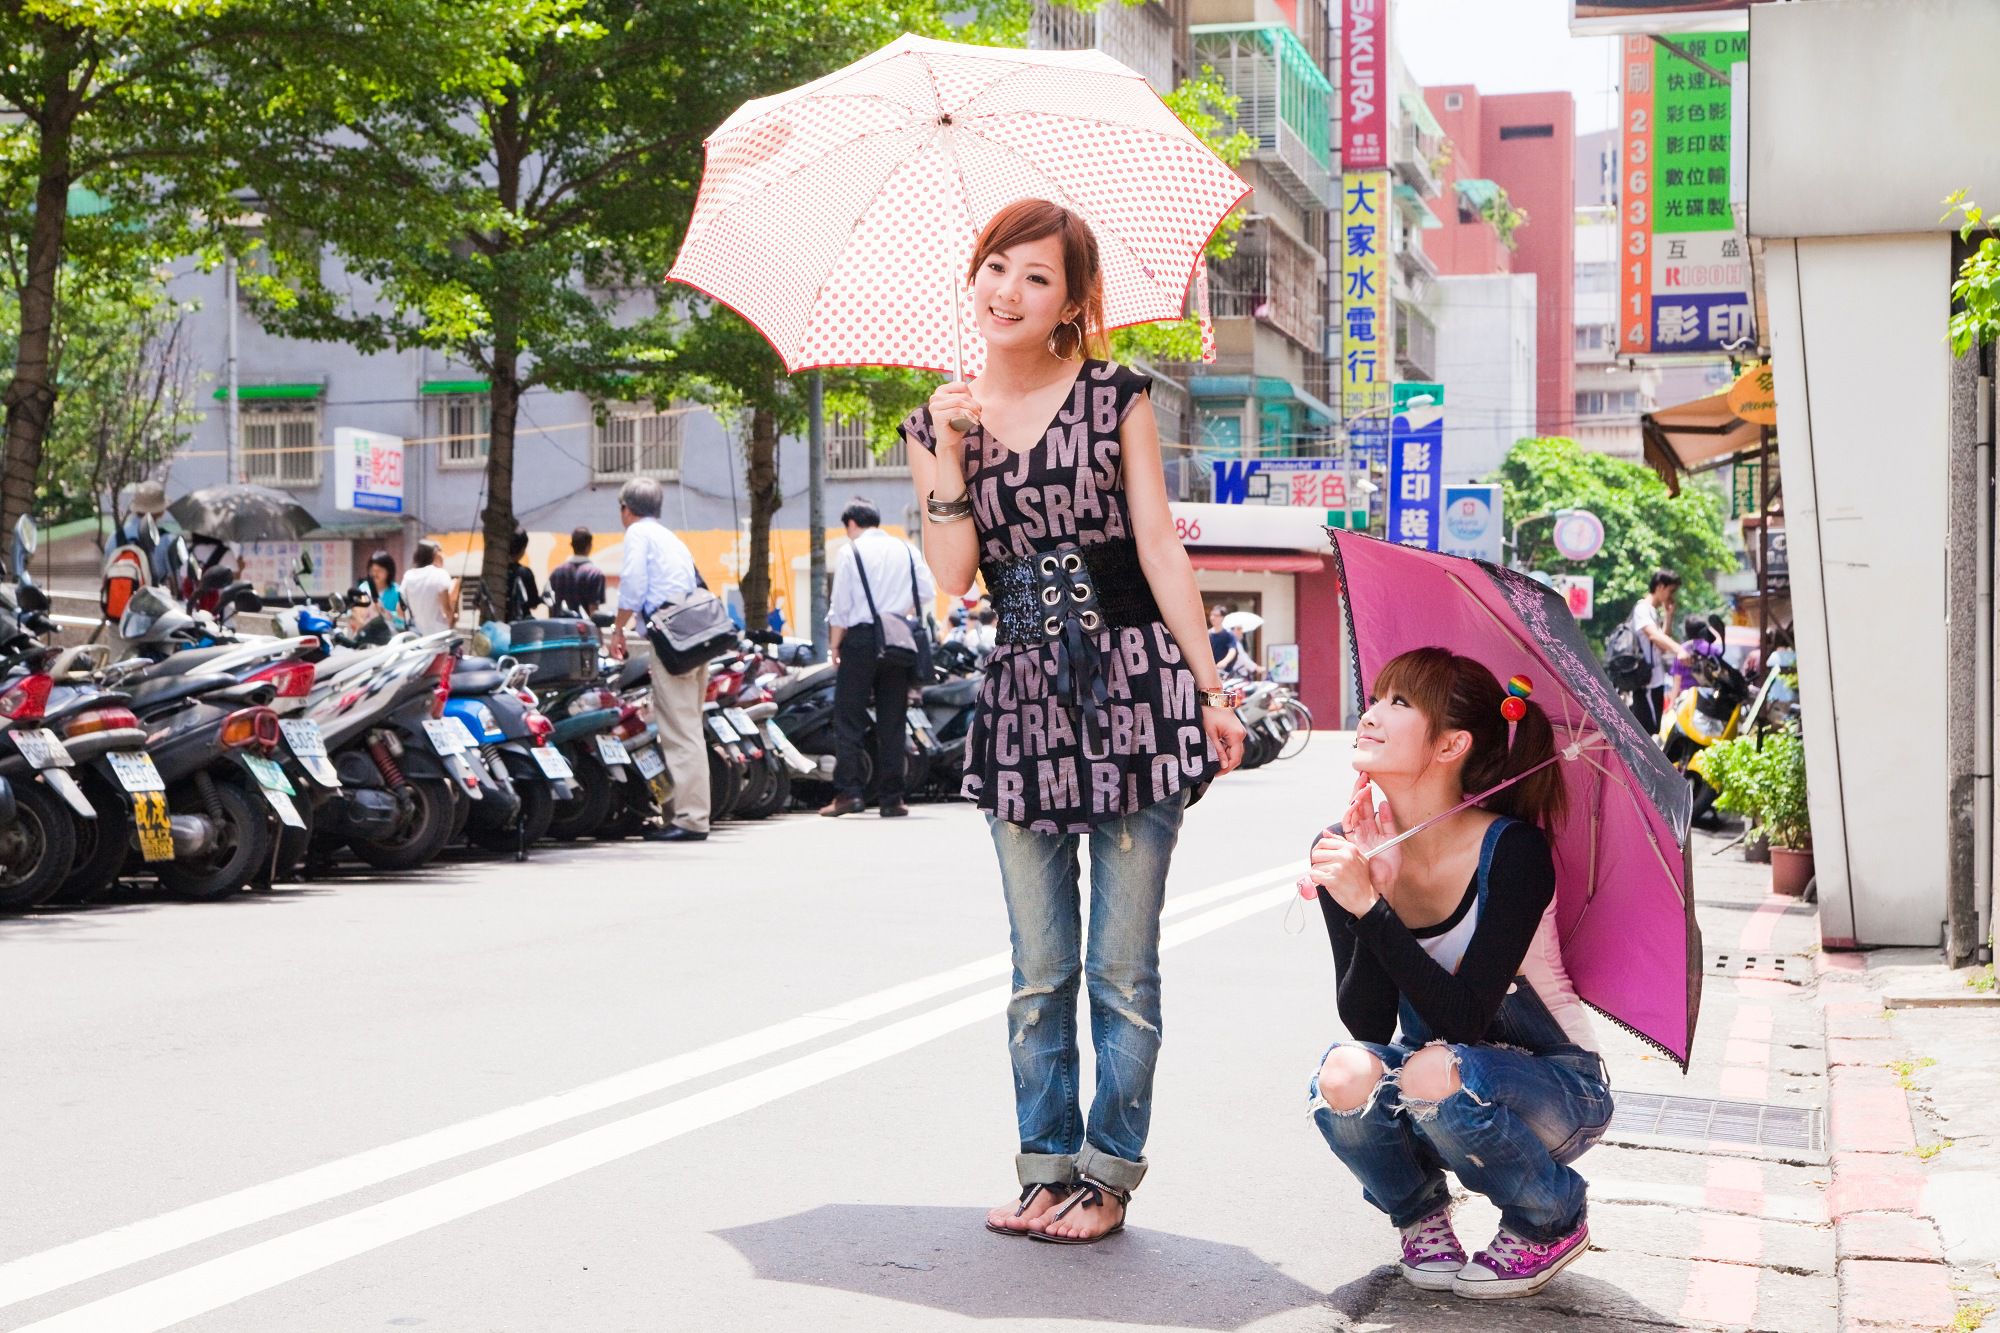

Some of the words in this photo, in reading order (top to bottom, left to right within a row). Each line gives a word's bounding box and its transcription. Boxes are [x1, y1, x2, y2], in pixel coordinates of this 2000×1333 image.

[1350, 0, 1375, 123] SAKURA
[1715, 37, 1747, 54] DM
[1347, 180, 1376, 383] 大家水電行
[1627, 109, 1648, 345] 23633114
[1656, 304, 1752, 344] 影印
[1400, 442, 1431, 549] 影印裝
